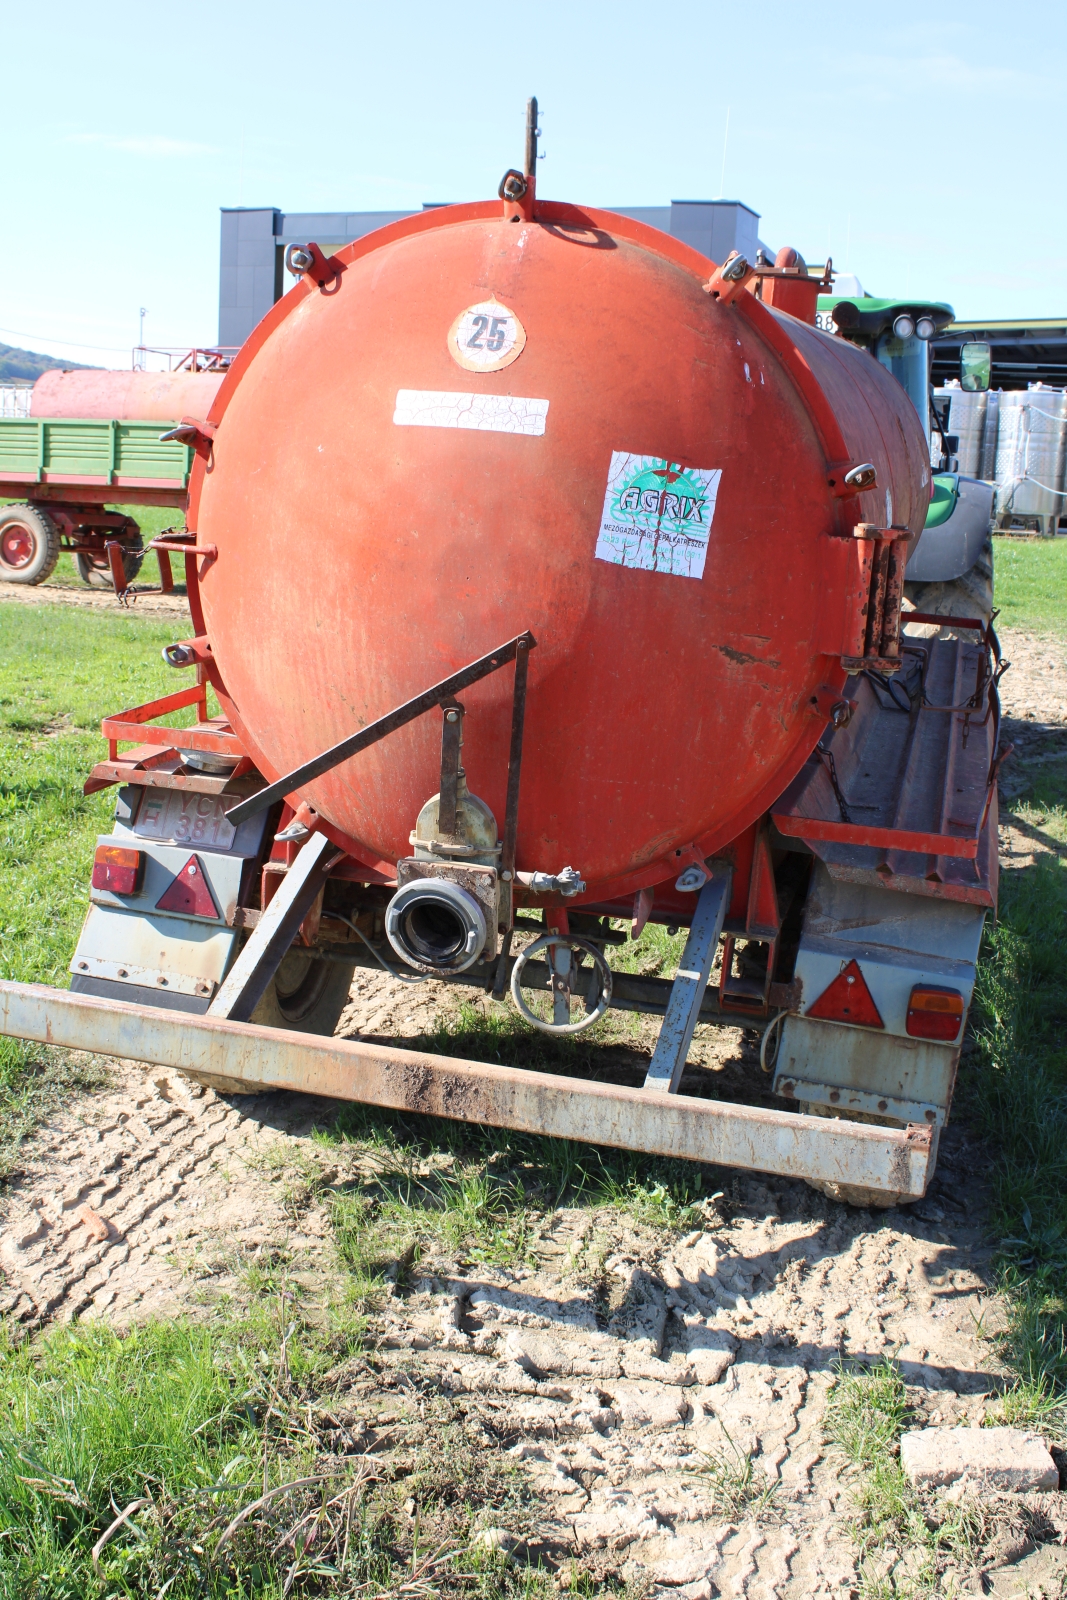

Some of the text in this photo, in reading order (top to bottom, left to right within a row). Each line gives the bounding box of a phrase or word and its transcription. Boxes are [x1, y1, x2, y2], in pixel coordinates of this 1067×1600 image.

[466, 315, 507, 352] 25
[620, 487, 706, 523] AGRIX
[182, 790, 233, 820] YCN
[142, 809, 221, 843] H 381
